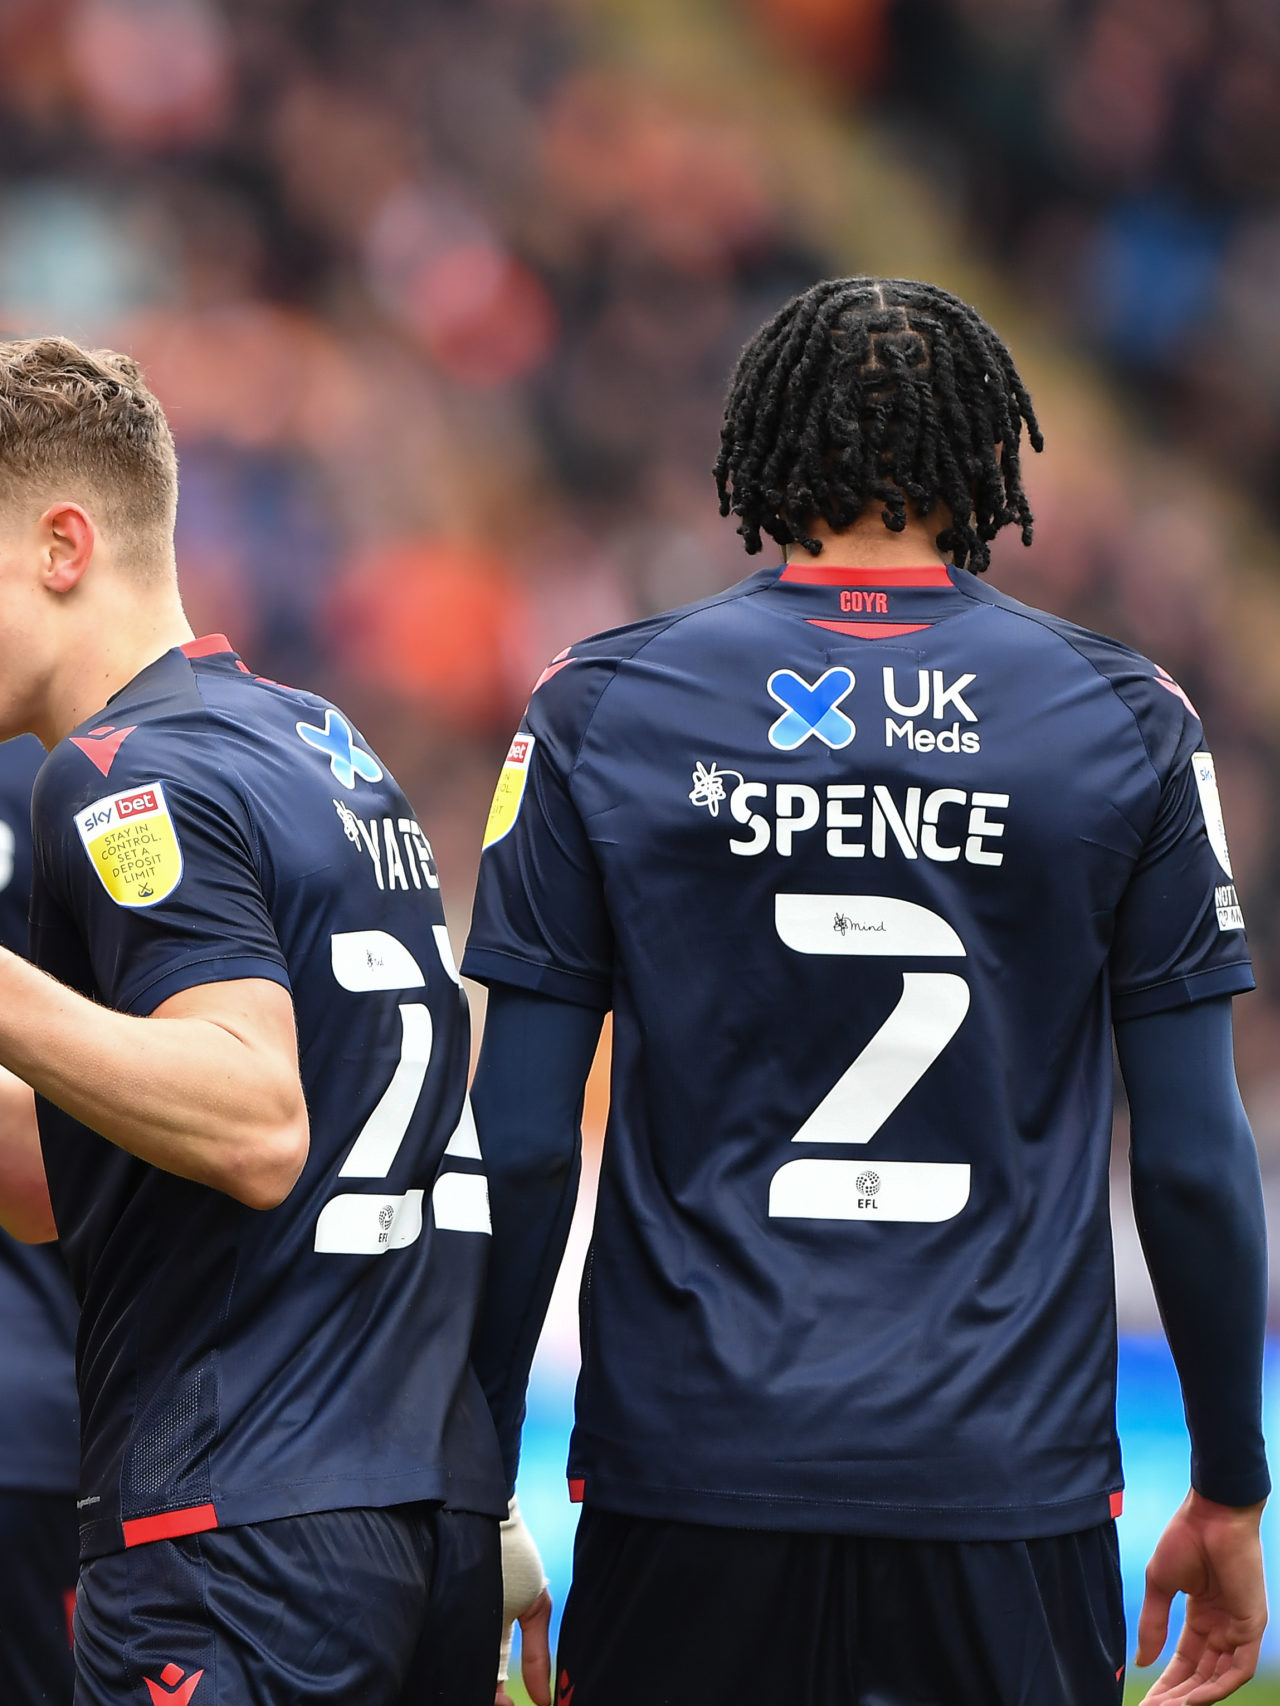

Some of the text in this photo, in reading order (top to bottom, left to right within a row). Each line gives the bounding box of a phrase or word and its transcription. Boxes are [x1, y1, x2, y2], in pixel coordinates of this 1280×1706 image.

[839, 590, 888, 614] COYR
[882, 666, 979, 722] UK
[884, 717, 981, 755] Meds
[84, 794, 154, 832] sky bet
[728, 781, 1011, 867] SPENCE
[101, 833, 162, 861] CONTROL.
[104, 823, 149, 847] STAY IN
[112, 853, 162, 878] DEPOSIT
[117, 847, 150, 863] SET A
[355, 817, 439, 891] YATE
[123, 866, 156, 884] LIMIT
[849, 920, 887, 932] mind
[768, 892, 972, 1224] 2
[857, 1198, 879, 1210] EFL
